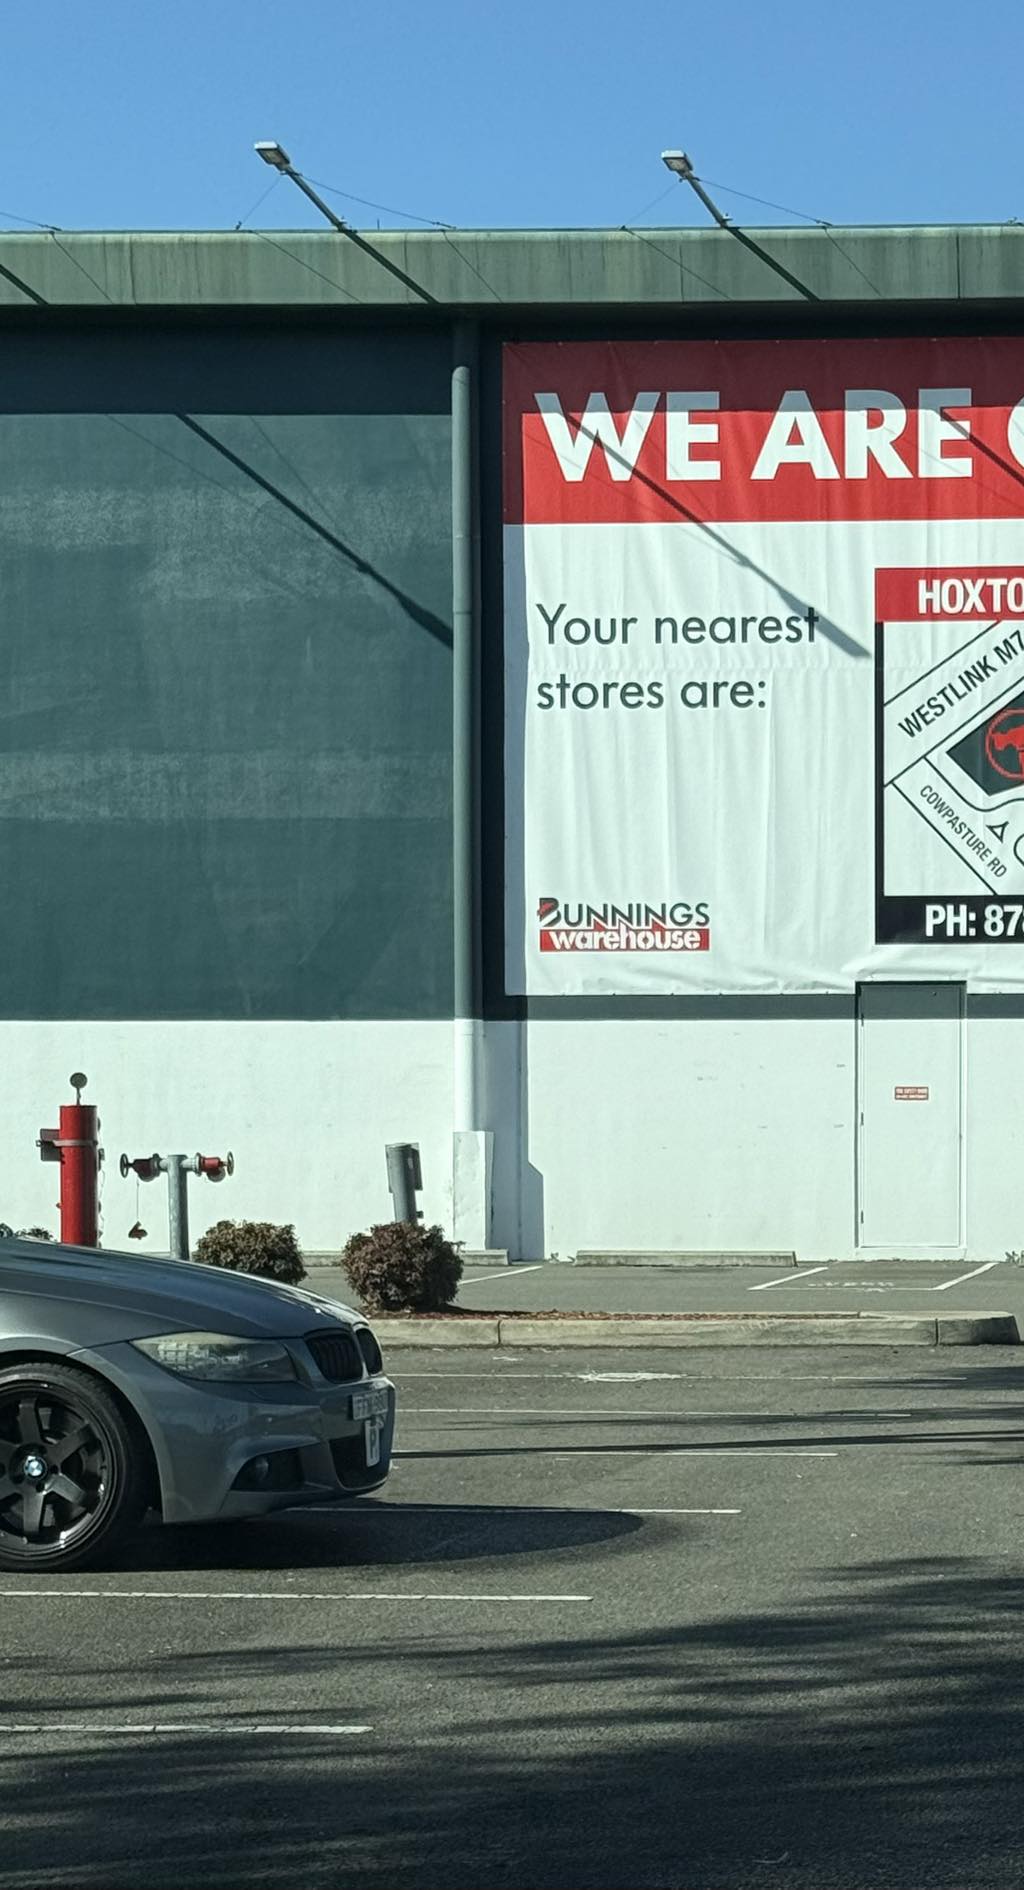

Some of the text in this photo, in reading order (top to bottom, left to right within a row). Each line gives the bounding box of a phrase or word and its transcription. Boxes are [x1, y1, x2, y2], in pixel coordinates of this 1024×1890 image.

[534, 390, 721, 482] WE
[750, 387, 973, 480] ARE
[536, 603, 820, 646] Your nearest
[536, 673, 768, 709] stores are:
[897, 654, 998, 739] WESTLINK
[919, 784, 1008, 878] COWPASTURE RD
[537, 897, 710, 928] BUNNINGS
[925, 903, 976, 937] PH:
[549, 921, 701, 950] warehouse
